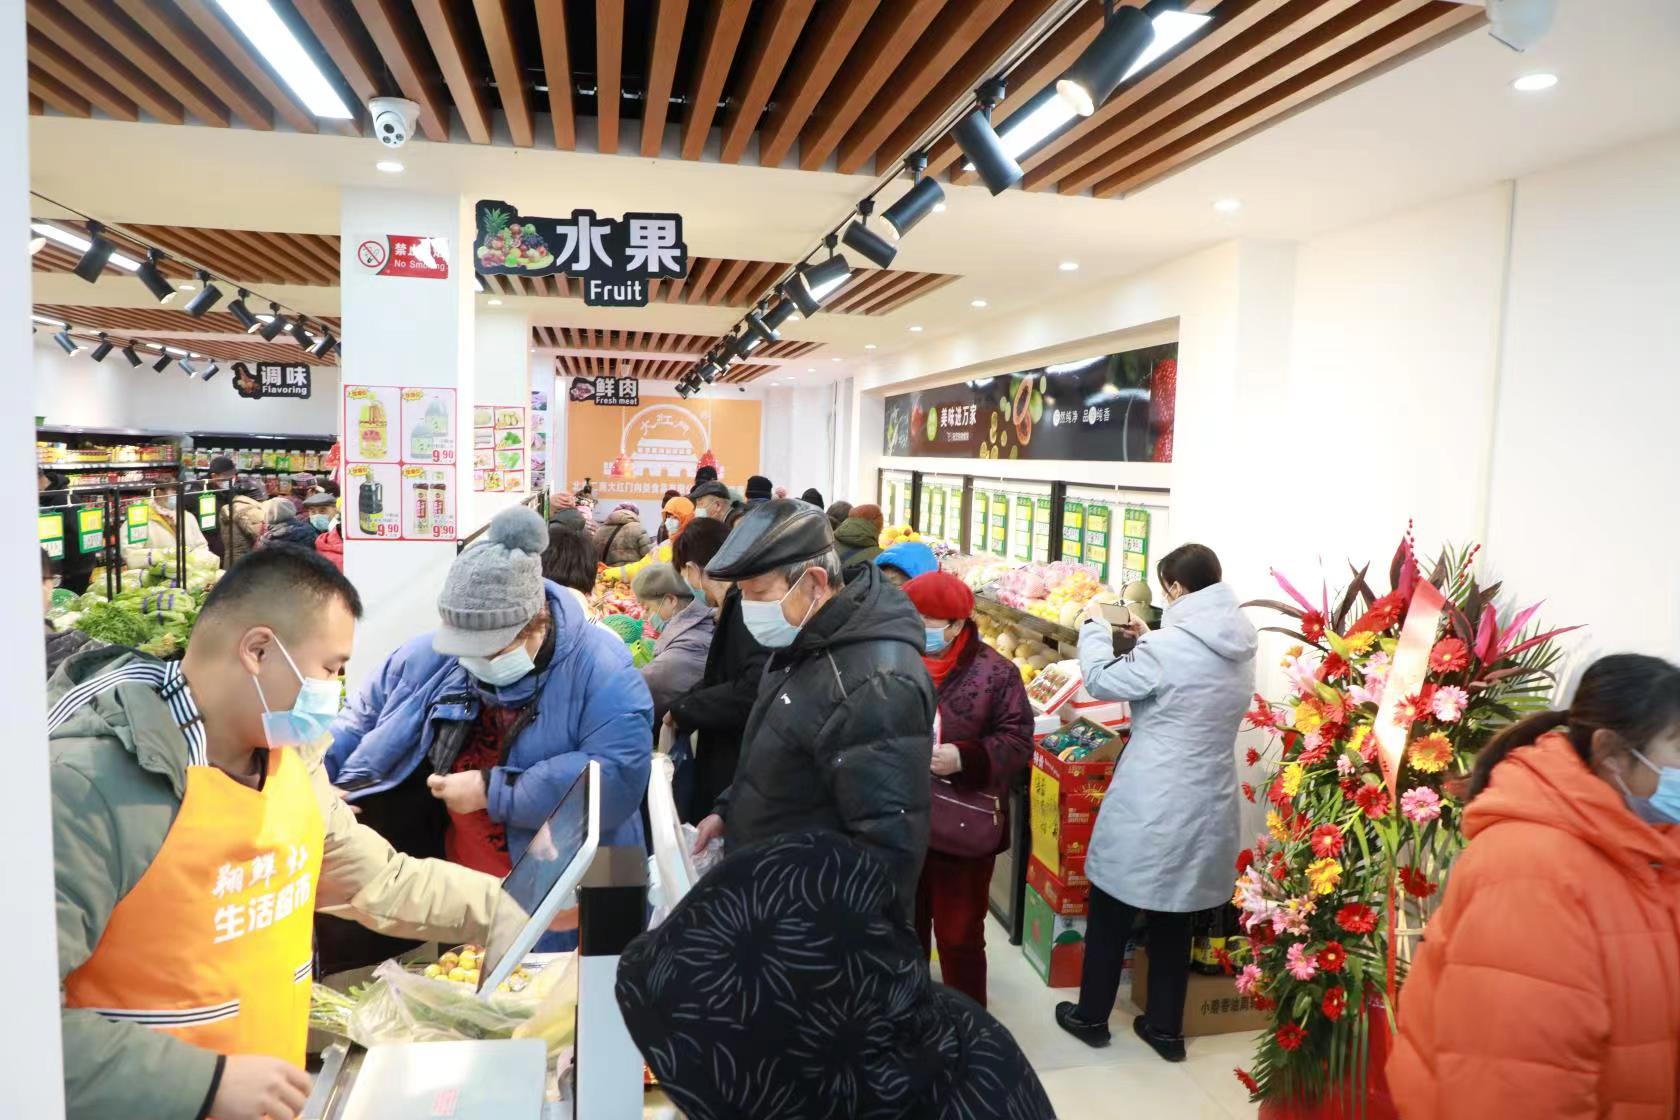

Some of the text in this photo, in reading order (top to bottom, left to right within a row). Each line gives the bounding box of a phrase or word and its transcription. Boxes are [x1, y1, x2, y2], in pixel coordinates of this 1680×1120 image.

[556, 216, 681, 272] 水果
[394, 259, 406, 268] No
[590, 279, 643, 301] Fruit
[261, 366, 307, 386] 调味
[262, 386, 307, 396] Flavoring
[595, 378, 637, 397] 鲜肉
[596, 396, 637, 405] Fresh meat
